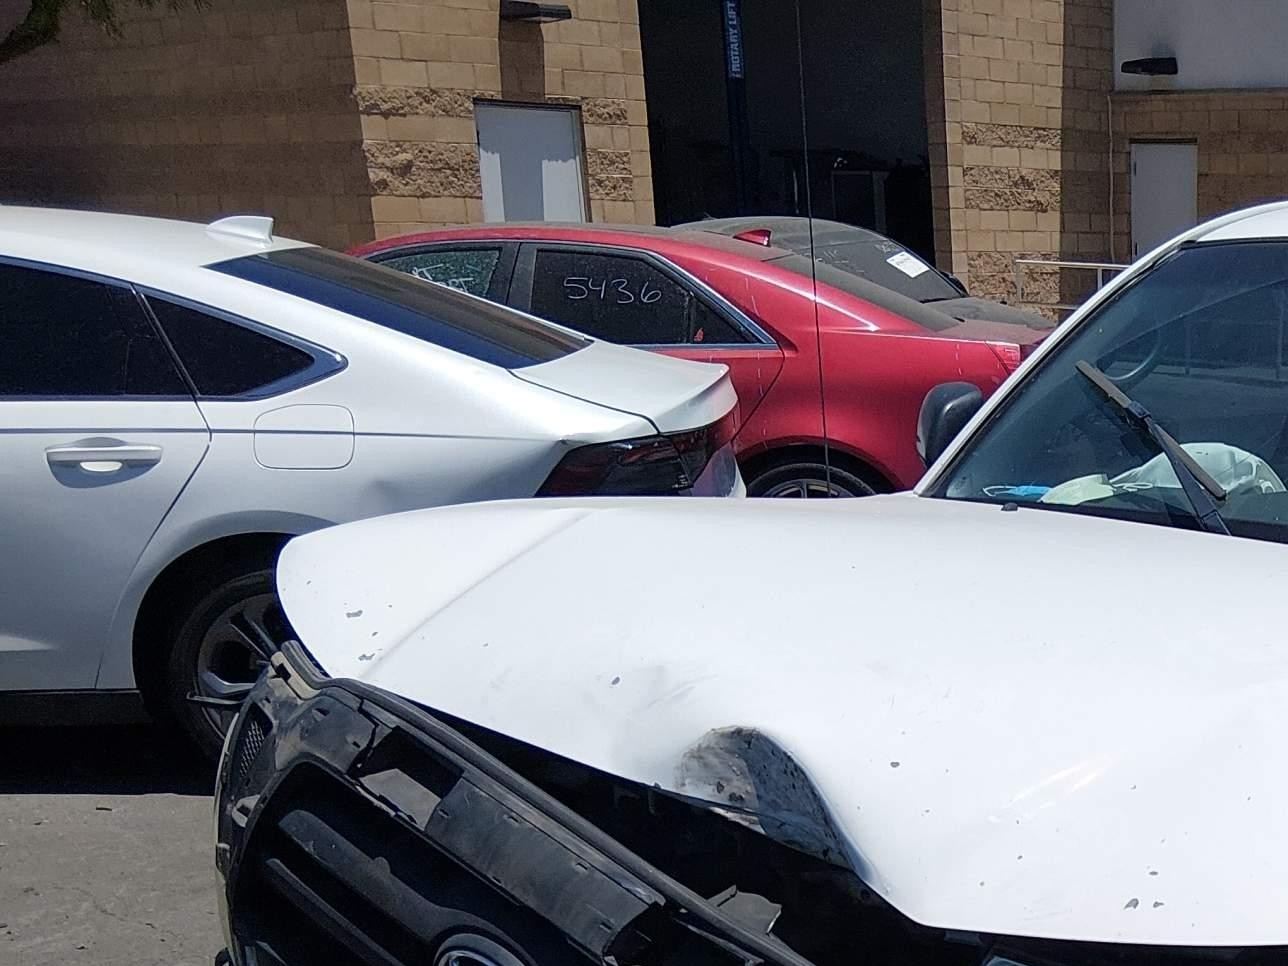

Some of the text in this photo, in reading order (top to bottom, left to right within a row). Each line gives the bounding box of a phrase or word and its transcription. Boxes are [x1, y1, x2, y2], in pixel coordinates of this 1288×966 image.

[726, 1, 741, 72] ROTARY LIFT
[563, 277, 662, 304] 5436
